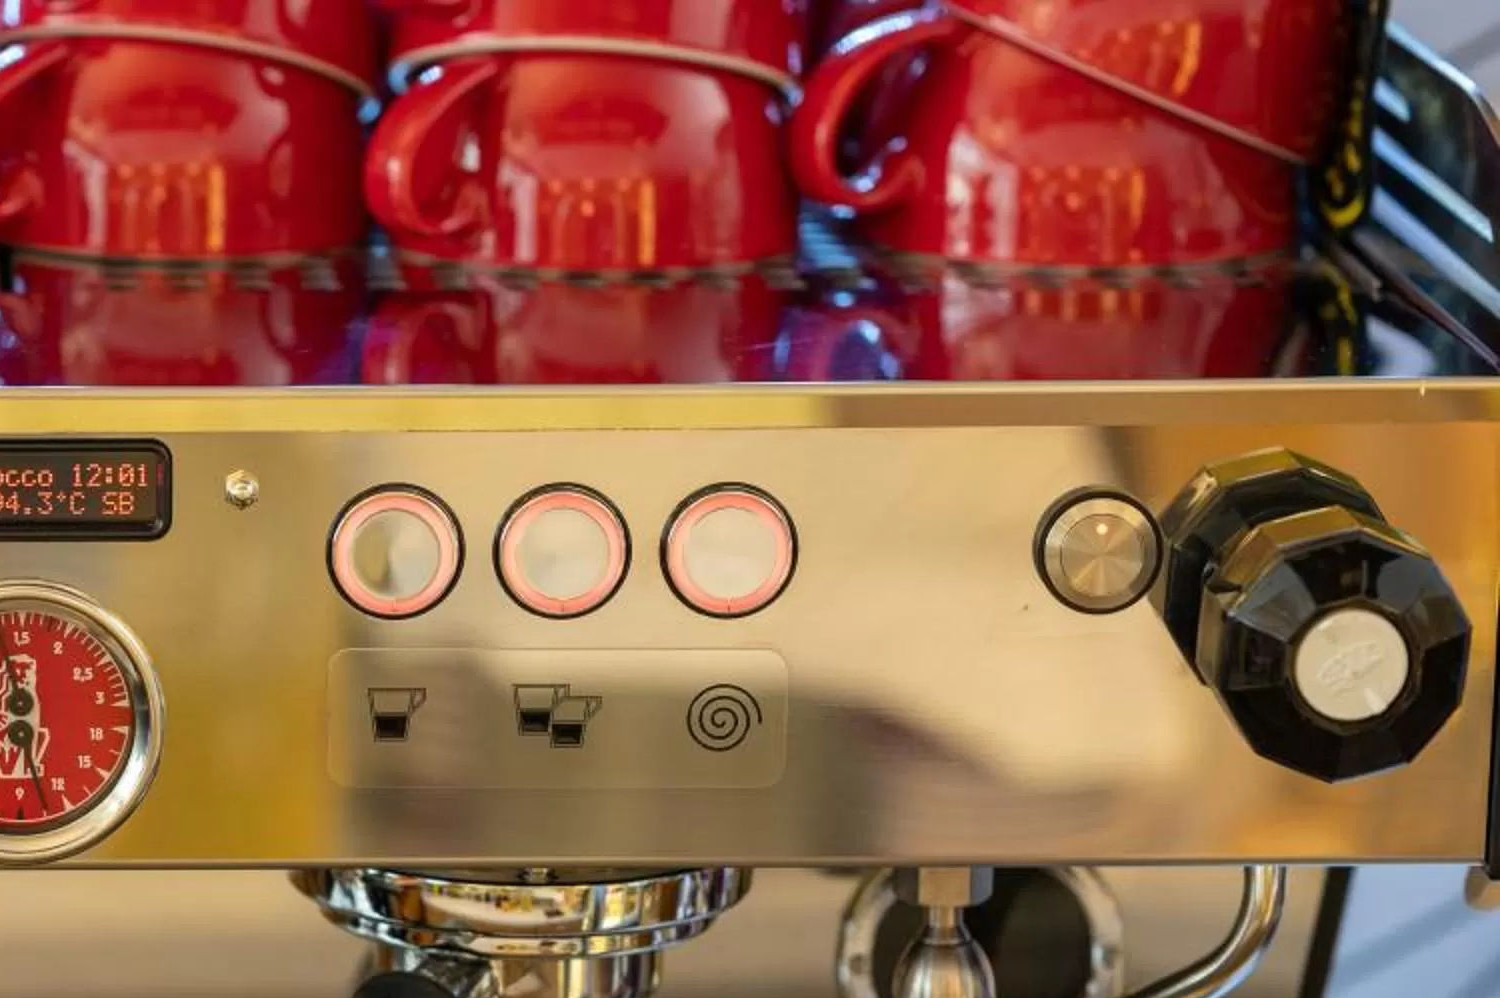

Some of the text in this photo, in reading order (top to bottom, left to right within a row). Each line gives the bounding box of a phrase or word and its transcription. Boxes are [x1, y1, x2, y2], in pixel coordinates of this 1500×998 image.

[72, 463, 149, 487] 12:01
[100, 492, 135, 516] SB
[53, 641, 63, 655] 2
[95, 691, 105, 705] 3
[89, 727, 104, 741] 18
[77, 755, 92, 769] 15
[51, 777, 65, 791] 12
[15, 786, 25, 800] 9
